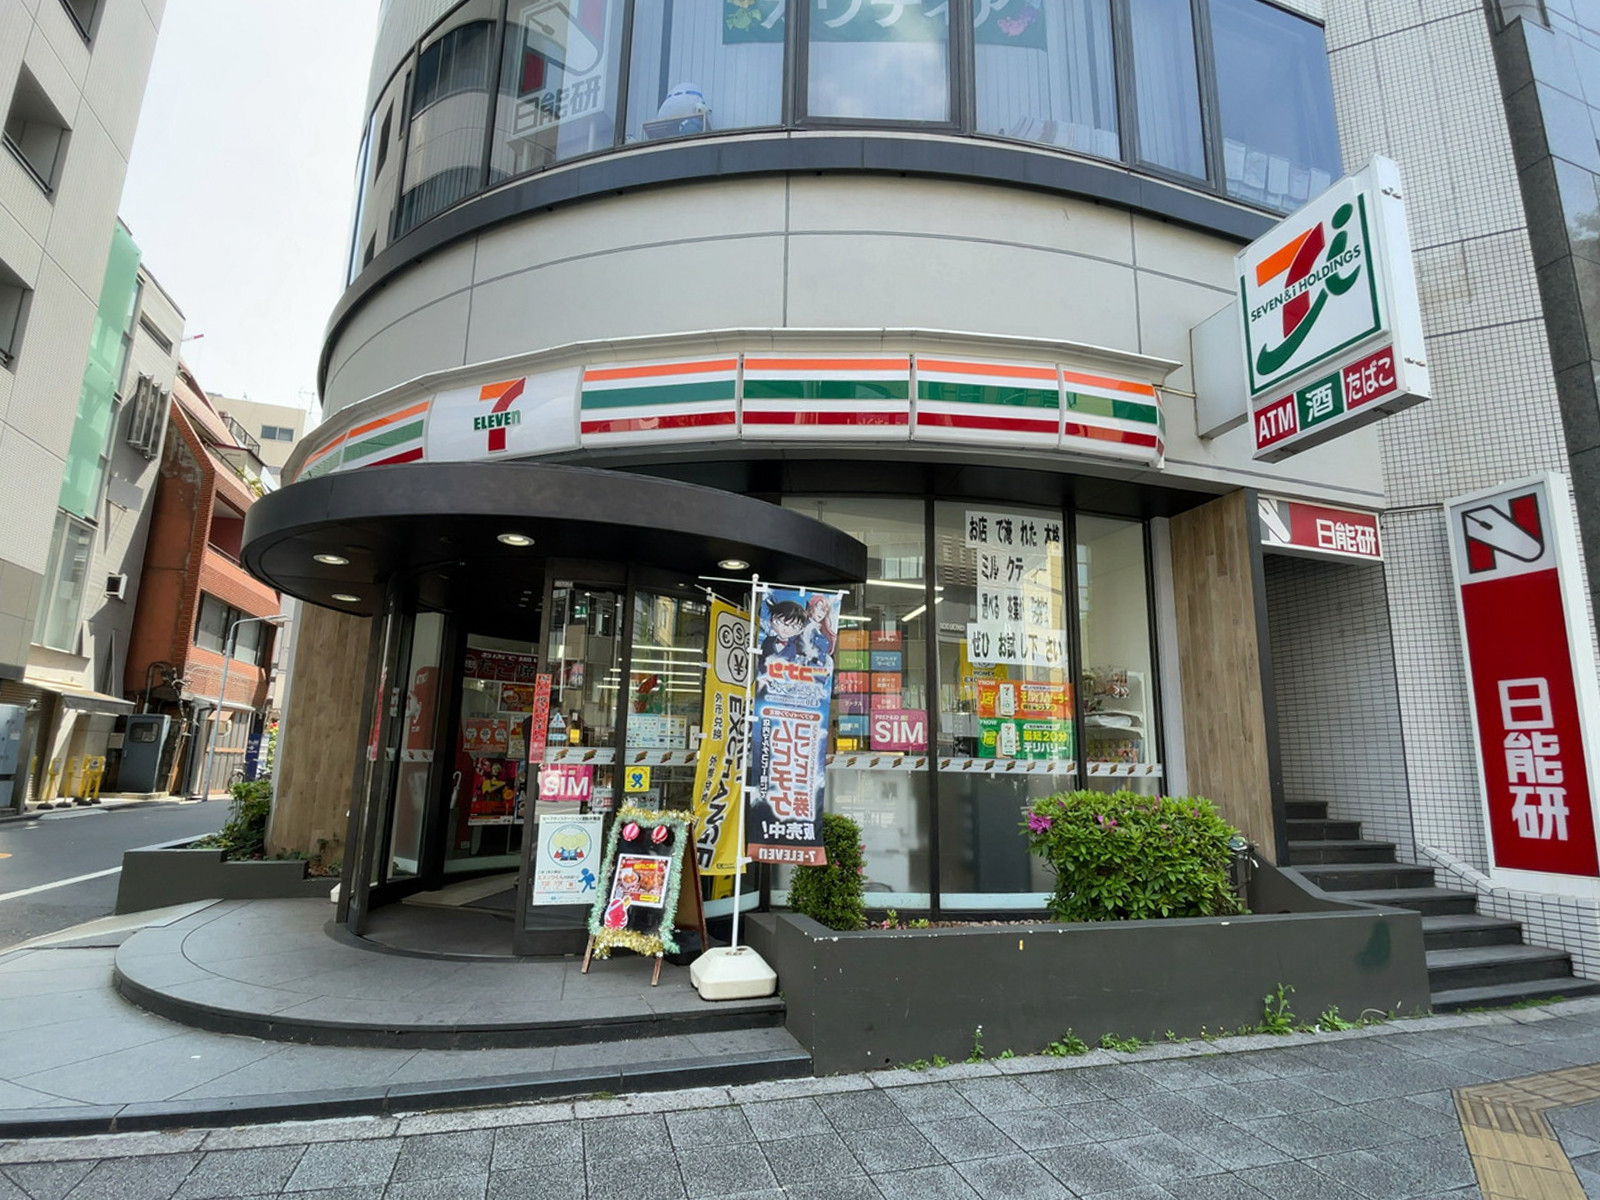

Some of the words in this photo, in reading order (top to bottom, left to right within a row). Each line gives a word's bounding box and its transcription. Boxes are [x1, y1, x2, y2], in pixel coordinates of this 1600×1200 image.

[1298, 243, 1362, 296] HOLDINGS
[1346, 354, 1395, 403] たばこ
[1305, 381, 1332, 422] 酒
[1258, 402, 1294, 443] ATM
[1316, 518, 1378, 555] 日能研
[874, 721, 924, 744] SIM
[1497, 676, 1571, 842] 日能研
[543, 775, 589, 797] SIM
